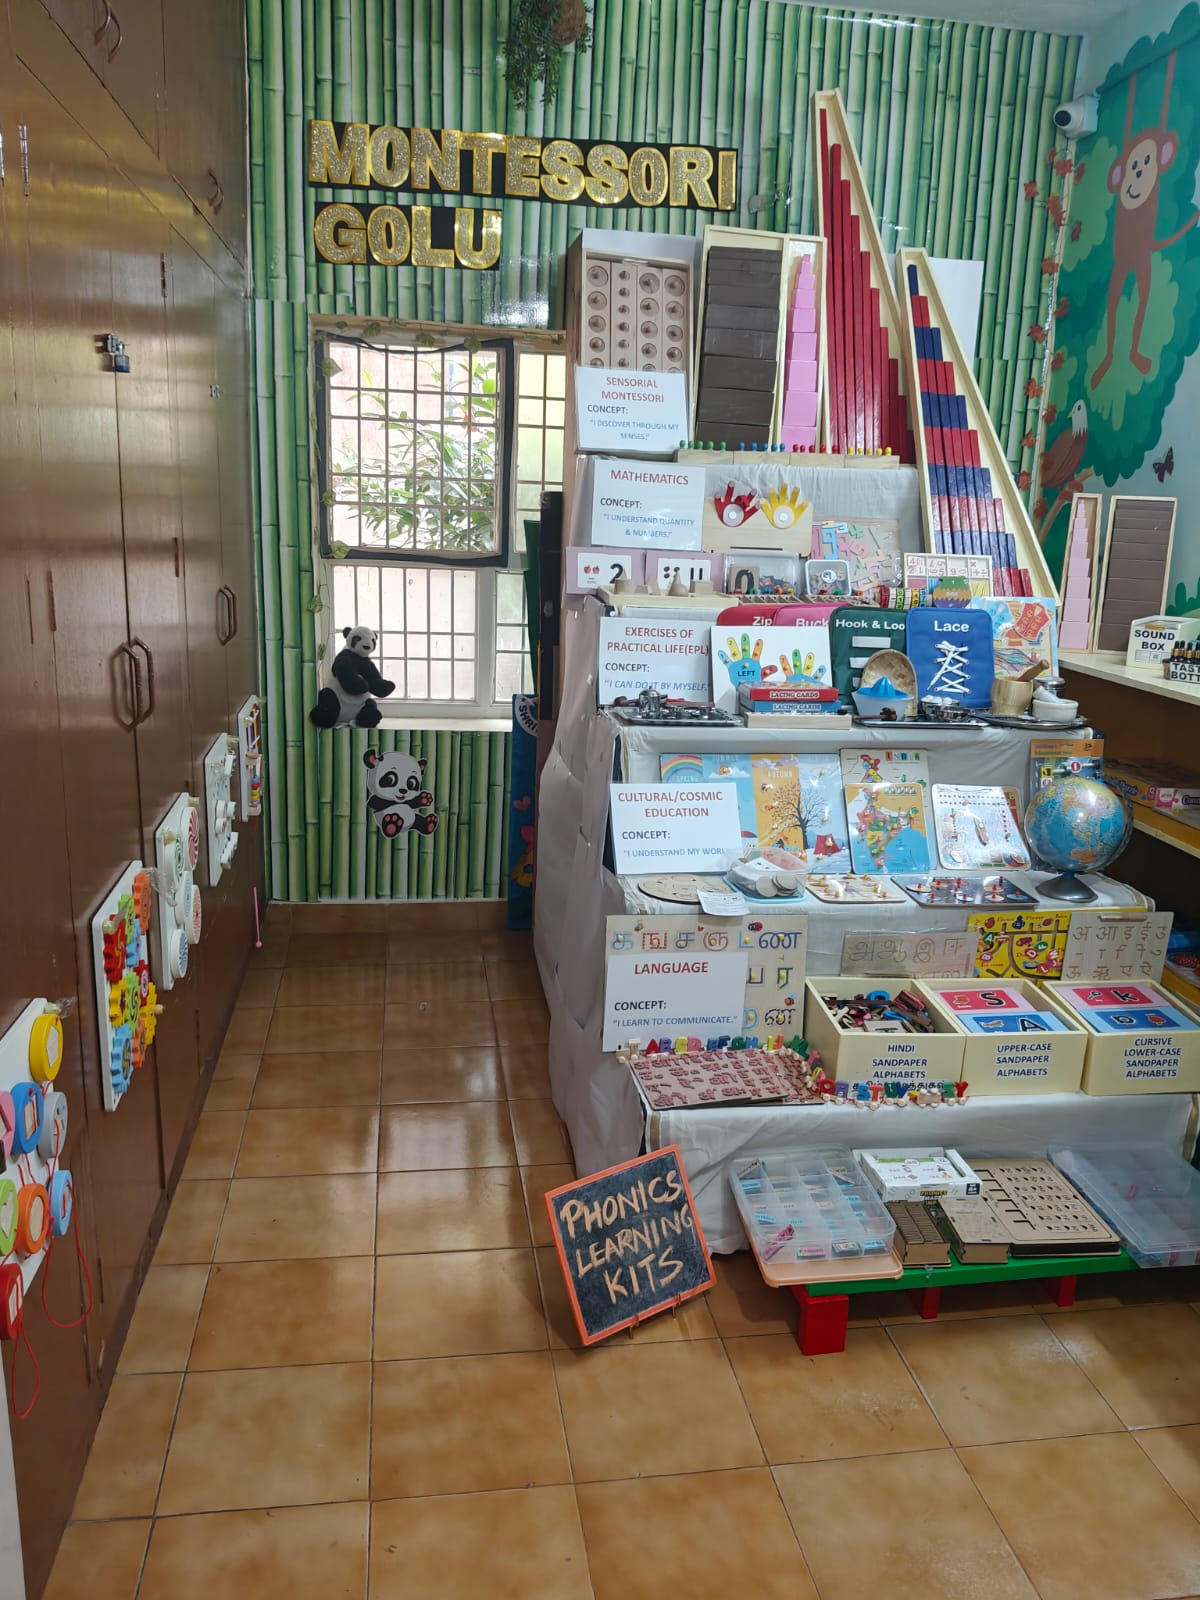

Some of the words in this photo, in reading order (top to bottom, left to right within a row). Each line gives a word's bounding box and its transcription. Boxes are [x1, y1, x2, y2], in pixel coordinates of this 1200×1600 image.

[309, 120, 737, 210] MONTESSORI
[313, 203, 501, 269] GOLU
[606, 377, 658, 388] SENSORIAL
[601, 391, 664, 403] MONTESSORI
[587, 404, 629, 415] CONCEPT:
[597, 420, 630, 429] DISCOVER
[632, 421, 667, 430] THROUGH
[610, 470, 689, 485] MATHEMATICS
[600, 498, 642, 509] CONCEPT:
[611, 514, 658, 524] UNDERSTAND
[659, 518, 695, 527] QUANTITY
[835, 619, 868, 629] Hook
[871, 620, 880, 629] &
[934, 620, 969, 632] Lace
[625, 626, 677, 638] EXERCISES
[679, 629, 694, 639] OF
[1134, 630, 1175, 641] SOUND
[607, 642, 662, 653] PRACTICAL
[1141, 641, 1165, 651] BOX
[605, 662, 650, 672] CONCEPT:
[614, 681, 633, 689] CAN
[635, 681, 648, 689] DO
[660, 682, 671, 690] BY
[618, 791, 723, 803] CULTURAL/COSMIC
[645, 808, 709, 818] EDUCATION
[622, 831, 670, 840] CONCEPT:
[632, 849, 686, 857] UNDERSTAND
[634, 962, 709, 975] LANGUAGE
[979, 992, 1006, 1006] S
[614, 1000, 667, 1011] CONCEPT:
[622, 1017, 652, 1027] LEARN
[654, 1017, 664, 1026] TO
[1134, 1037, 1173, 1046] CURSIVE
[887, 1044, 915, 1053] HINDI
[997, 1043, 1052, 1053] UPPER-CASE
[1124, 1048, 1182, 1057] LOWER-CASE
[872, 1058, 928, 1067] SANDPAPER
[996, 1055, 1050, 1065] SANDPAPER
[1126, 1059, 1179, 1068] SANDPAPER
[872, 1070, 926, 1079] ALPHABETS
[996, 1068, 1048, 1077] ALPHABETS
[1126, 1069, 1177, 1078] ALPHABETS
[560, 1170, 681, 1239] PHONICS
[576, 1203, 694, 1278] LEARNING
[603, 1246, 683, 1304] KITS
